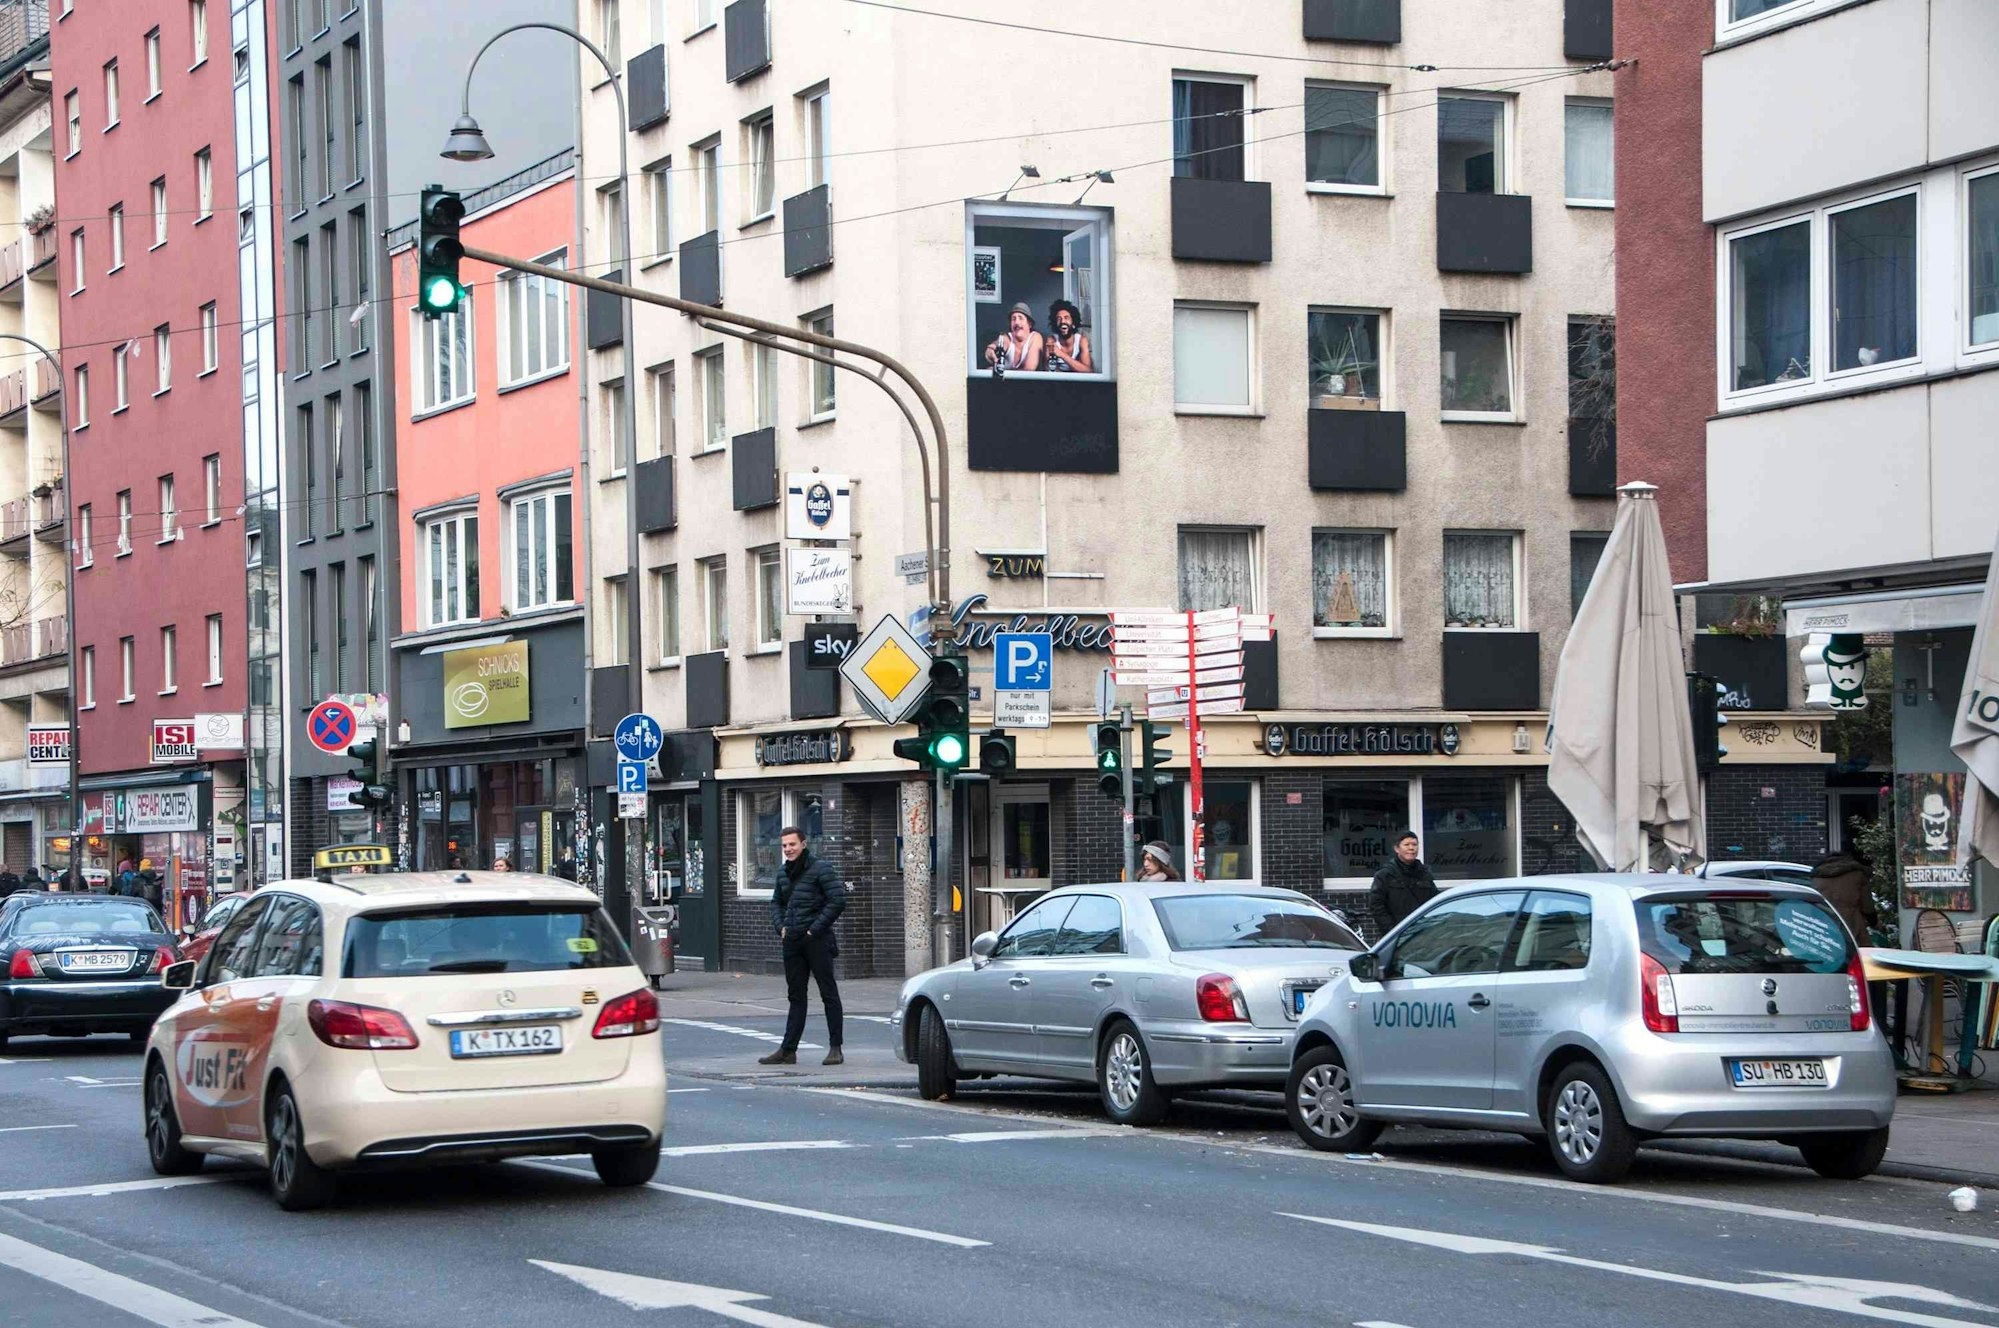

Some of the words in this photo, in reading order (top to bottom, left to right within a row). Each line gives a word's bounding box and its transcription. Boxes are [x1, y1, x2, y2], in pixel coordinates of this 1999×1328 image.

[807, 499, 832, 511] Gaffel
[810, 553, 831, 567] Zum
[900, 558, 925, 572] Aachener
[991, 557, 1044, 576] ZUM
[793, 563, 848, 586] Knobelbecher
[814, 634, 852, 659] sky
[478, 652, 520, 677] SCHNICKS
[1008, 640, 1039, 684] P
[488, 676, 520, 691] SPIELHALLE
[1023, 692, 1035, 700] mit
[1005, 703, 1040, 711] Parkschein
[997, 715, 1025, 724] werktags
[155, 726, 195, 745] ISI
[155, 744, 196, 756] MOBILE
[622, 766, 638, 792] P
[137, 793, 160, 817] REPAIR
[161, 792, 187, 817] CENTER
[333, 849, 377, 863] TAXI
[1340, 838, 1388, 858] Gaffel
[1904, 868, 1932, 883] HERR
[1932, 867, 1969, 882] PIMOCK
[71, 955, 78, 965] K
[84, 955, 99, 965] MB
[100, 954, 126, 965] 2579
[469, 1032, 482, 1050] K
[492, 1031, 517, 1048] TX
[521, 1028, 554, 1047] 162
[185, 1043, 221, 1089] Just
[223, 1048, 248, 1091] Fit
[1743, 1063, 1764, 1081] SU
[1774, 1063, 1794, 1080] HB
[1797, 1063, 1825, 1080] 130
